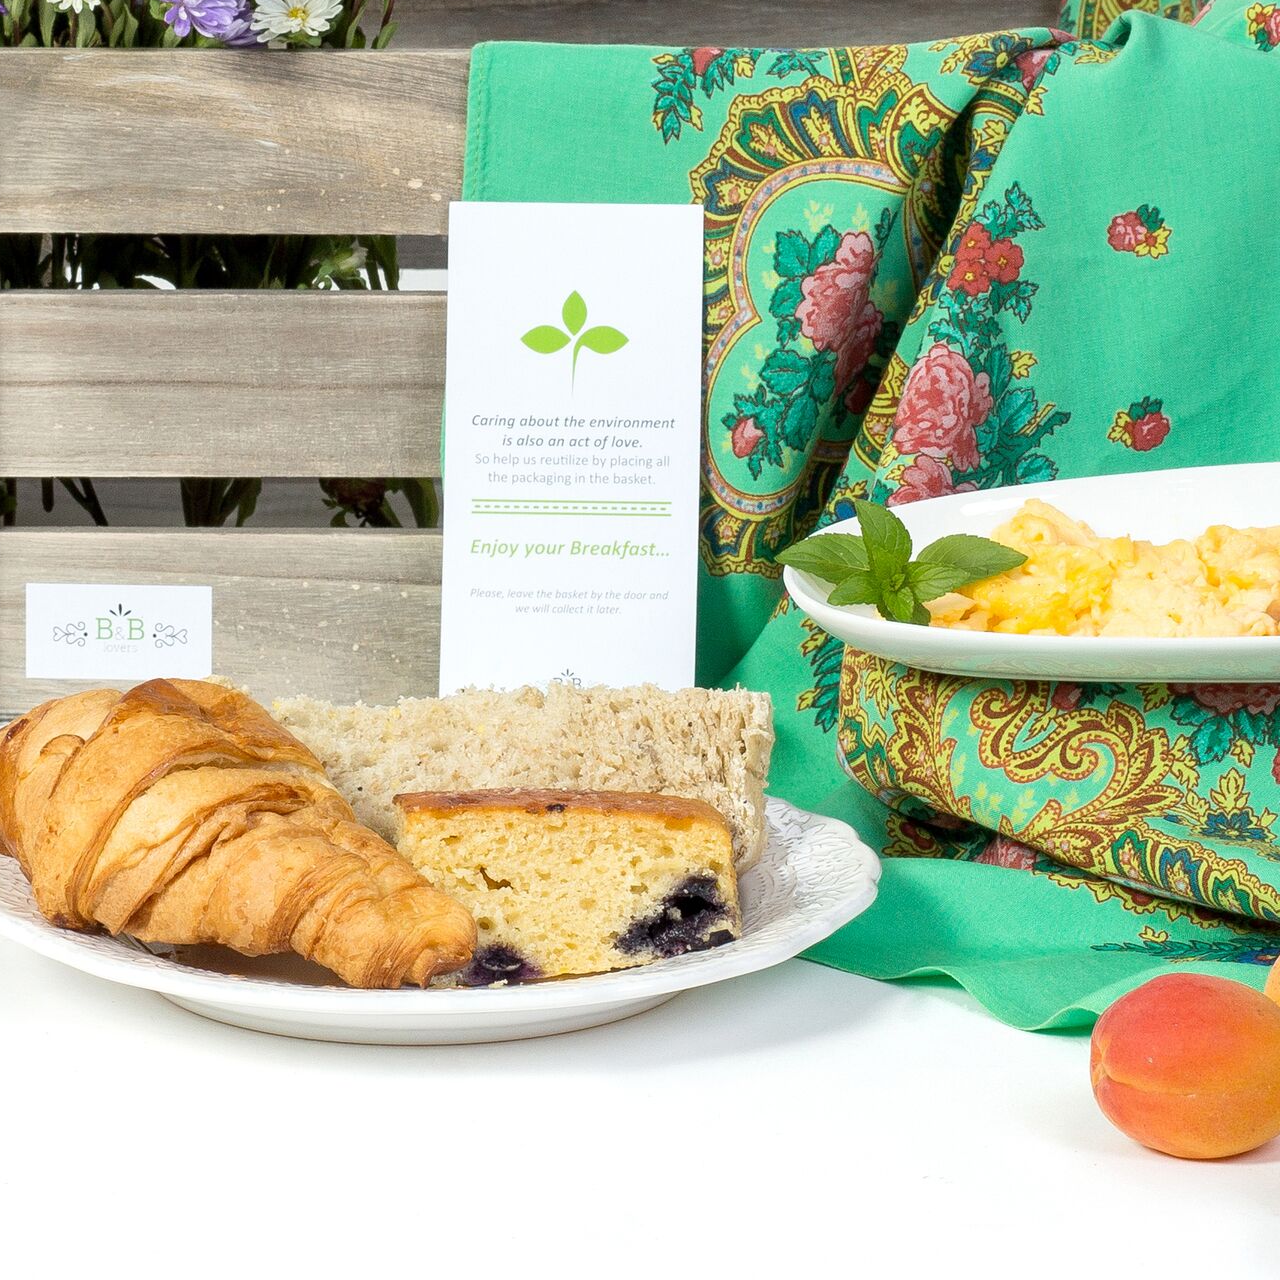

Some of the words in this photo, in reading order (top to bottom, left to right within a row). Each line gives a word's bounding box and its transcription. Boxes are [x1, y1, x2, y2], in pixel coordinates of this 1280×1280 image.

[472, 414, 515, 429] Caring
[519, 415, 559, 427] about
[564, 415, 585, 428] the
[589, 416, 675, 429] environment
[502, 434, 512, 446] is
[516, 434, 544, 447] also
[548, 437, 565, 447] an
[569, 436, 590, 448] act
[593, 435, 609, 450] of
[611, 435, 643, 448] love.
[474, 452, 490, 465] So
[493, 452, 520, 468] help
[523, 455, 537, 465] us
[540, 453, 589, 466] reutilize
[592, 454, 607, 469] by
[610, 455, 653, 470] placing
[656, 455, 670, 467] all
[488, 471, 508, 483] the
[512, 471, 572, 486] packaging
[575, 472, 586, 484] in
[589, 472, 610, 484] the
[613, 472, 656, 485] basket.
[470, 539, 519, 558] Enjoy
[524, 543, 566, 559] your
[570, 540, 670, 560] Breakfast...
[470, 587, 505, 599] Please,
[507, 588, 534, 599] leave
[536, 589, 553, 599] the
[555, 588, 588, 599] basket
[591, 589, 603, 601] by
[605, 590, 621, 600] the
[624, 590, 647, 600] door
[649, 590, 670, 600] and
[515, 605, 530, 614] we
[532, 603, 550, 614] will
[552, 604, 584, 614] collect
[587, 605, 594, 615] it
[596, 604, 622, 615] later.
[95, 617, 145, 640] B&B
